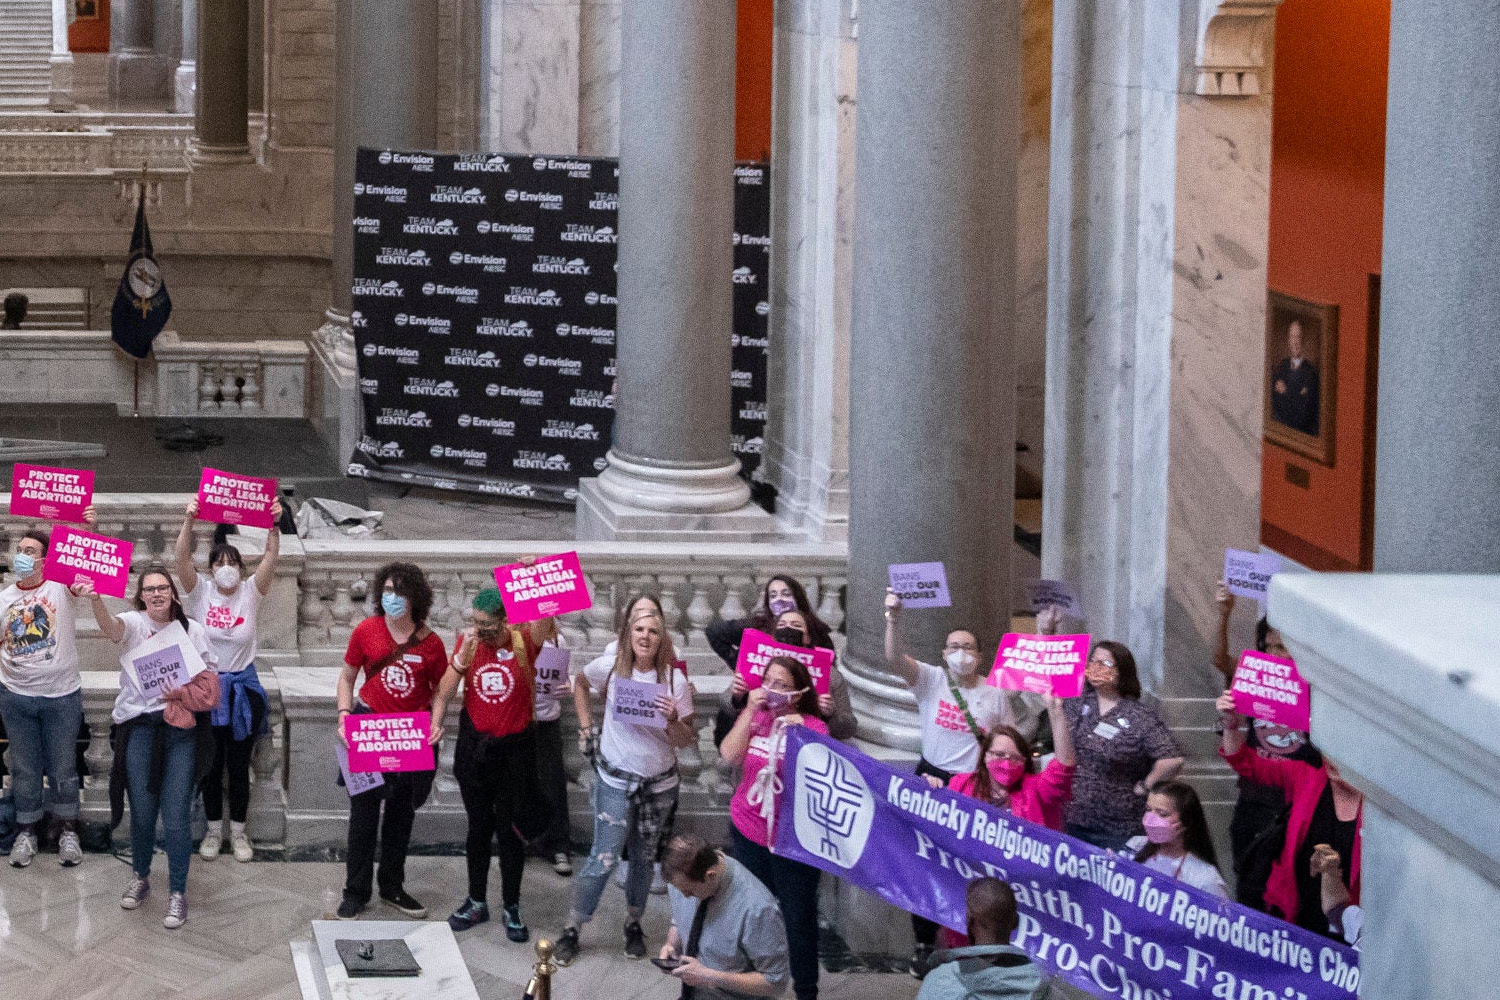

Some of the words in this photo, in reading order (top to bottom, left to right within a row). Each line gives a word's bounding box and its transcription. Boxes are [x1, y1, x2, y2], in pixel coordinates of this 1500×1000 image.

[393, 154, 434, 165] Envision
[547, 160, 592, 171] Envision
[454, 162, 510, 172] KENTUCKY
[366, 185, 407, 196] Envision
[430, 193, 486, 204] KENTUCKY
[518, 191, 563, 203] Envision
[403, 224, 459, 235] KENTUCKY
[491, 223, 535, 234] Envision
[561, 232, 618, 243] KENTUCKY
[376, 255, 431, 265] KENTUCKY
[464, 254, 507, 265] Envision
[532, 263, 590, 274] KENTUCKY
[436, 285, 479, 296] Envision
[504, 295, 562, 306] KENTUCKY
[409, 315, 451, 327] Envision
[476, 325, 534, 336] KENTUCKY
[571, 325, 615, 336] Envision
[377, 346, 419, 357] Envision
[444, 355, 500, 367] KENTUCKY
[538, 355, 582, 367] Envision
[404, 386, 460, 396] KENTUCKY
[500, 386, 544, 397] Envision
[28, 470, 80, 484] PROTECT
[18, 479, 49, 492] SAFE,
[51, 483, 87, 496] LEGAL
[213, 475, 263, 492] PROTECT
[21, 489, 81, 505] ABORTION
[203, 483, 234, 498] SAFE,
[236, 489, 270, 504] LEGAL
[205, 495, 266, 511] ABORTION
[67, 533, 117, 554] PROTECT
[55, 542, 87, 560] SAFE,
[89, 550, 123, 567] LEGAL
[57, 554, 118, 577] ABORTION
[510, 559, 563, 580] PROTECT
[504, 579, 537, 593] SAFE,
[539, 569, 577, 587] LEGAL
[916, 581, 940, 590] OUR
[1228, 577, 1267, 592] BODIES
[513, 580, 576, 603] ABORTION
[1016, 638, 1075, 653] PROTECT
[1001, 648, 1043, 664] SAFE,
[1045, 650, 1081, 664] LEGAL
[138, 659, 162, 673] BANS
[159, 662, 181, 675] OUR
[1002, 659, 1075, 675] ABORTION
[1242, 655, 1292, 678] PROTECT
[540, 668, 560, 680] UR
[1233, 680, 1298, 706] ABORTION
[638, 700, 655, 708] OU
[616, 705, 655, 718] BODIES
[360, 718, 414, 730] PROTECT
[351, 730, 385, 743] SAFE,
[387, 729, 425, 741] LEGAL
[357, 740, 421, 752] ABORTION
[887, 775, 970, 839] Kentucky
[971, 809, 1051, 868] Religious
[1054, 842, 1136, 903] Coalition
[1138, 876, 1171, 916] for
[1169, 889, 1313, 973] Reproductive
[1319, 946, 1360, 993] Cho
